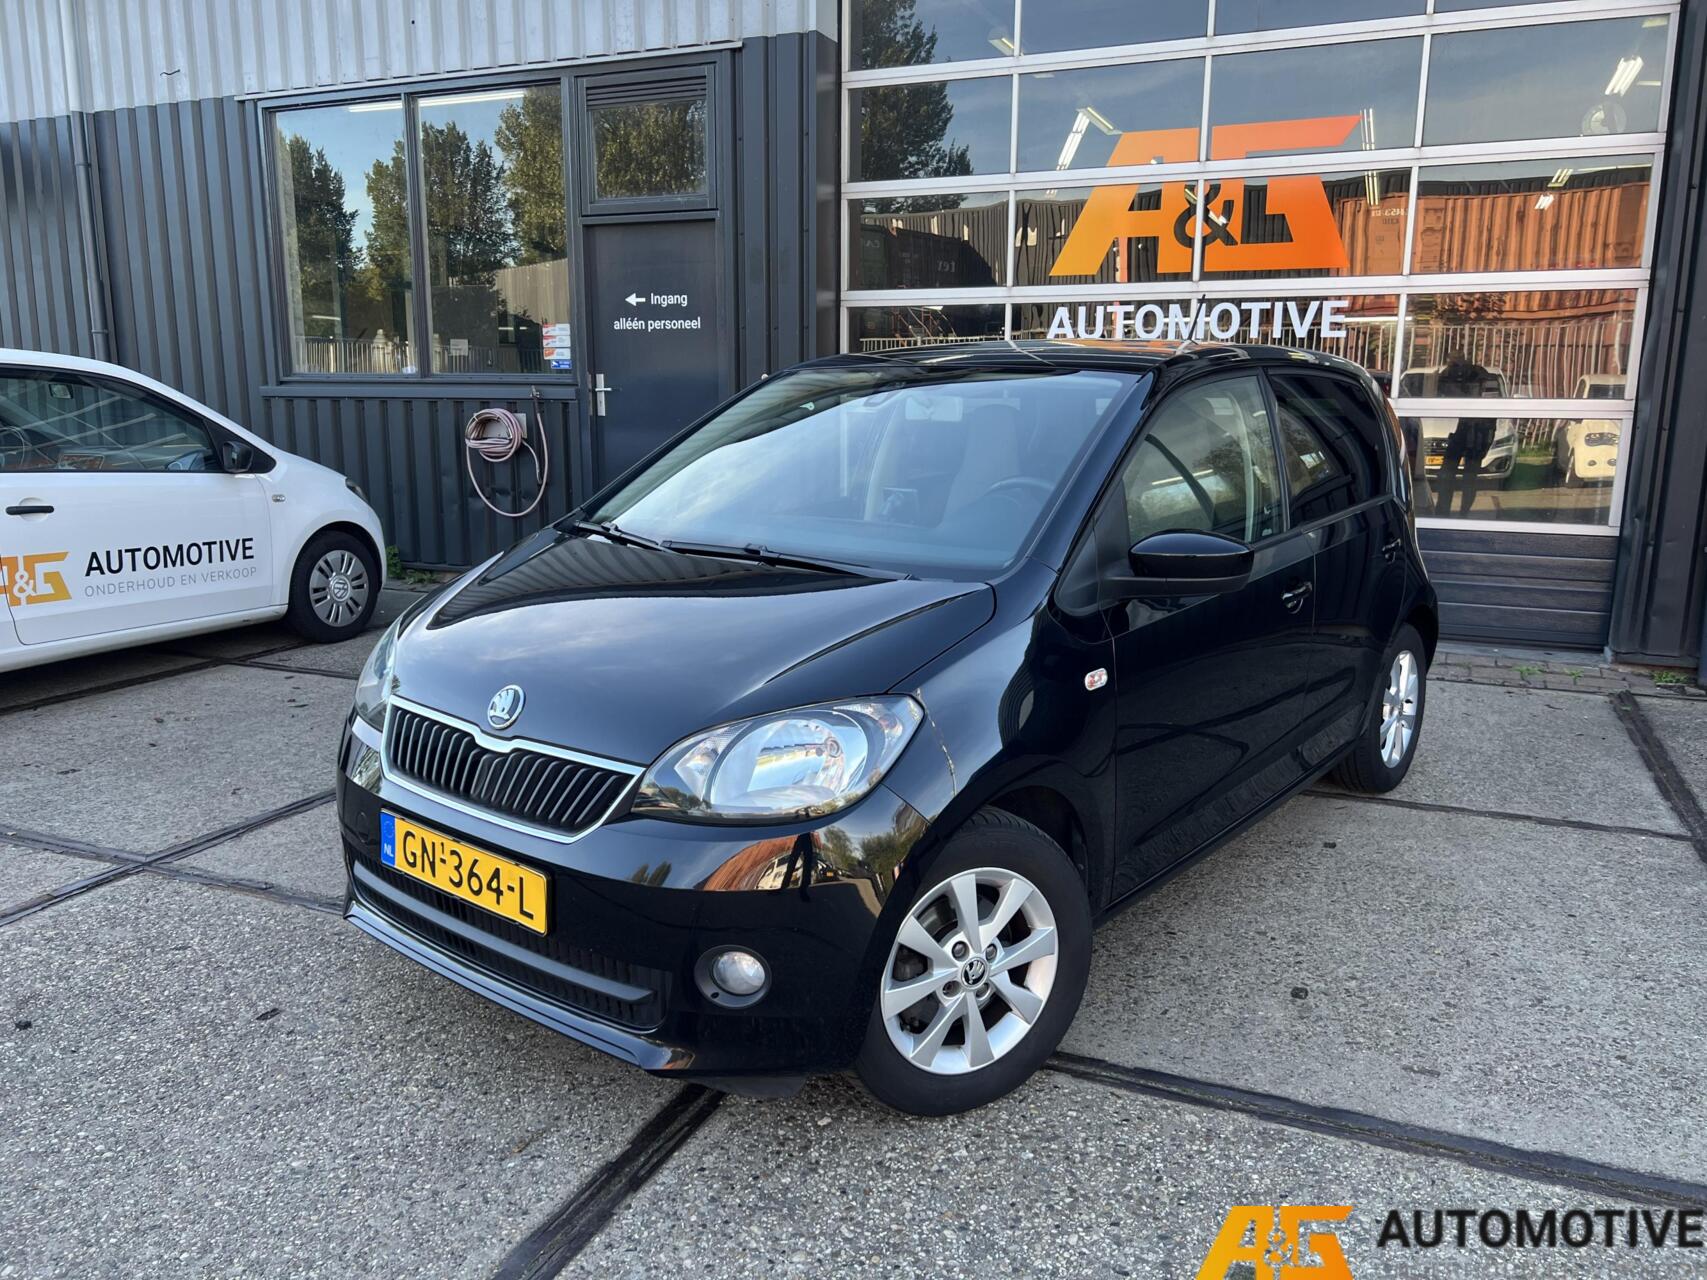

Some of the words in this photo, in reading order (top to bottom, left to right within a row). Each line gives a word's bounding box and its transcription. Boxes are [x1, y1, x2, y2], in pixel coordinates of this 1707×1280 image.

[1049, 115, 1362, 276] A&G
[651, 293, 688, 308] Ingang
[1046, 300, 1349, 340] AUTOMOTIVE
[613, 318, 645, 331] alléén
[648, 317, 701, 332] personeel
[85, 537, 255, 577] AUTOMOTIVE
[84, 575, 175, 598] ONDERHOUD
[180, 575, 197, 585] EN
[202, 566, 258, 584] VERKOOP
[383, 843, 394, 858] NL
[402, 830, 534, 920] GN-364-L
